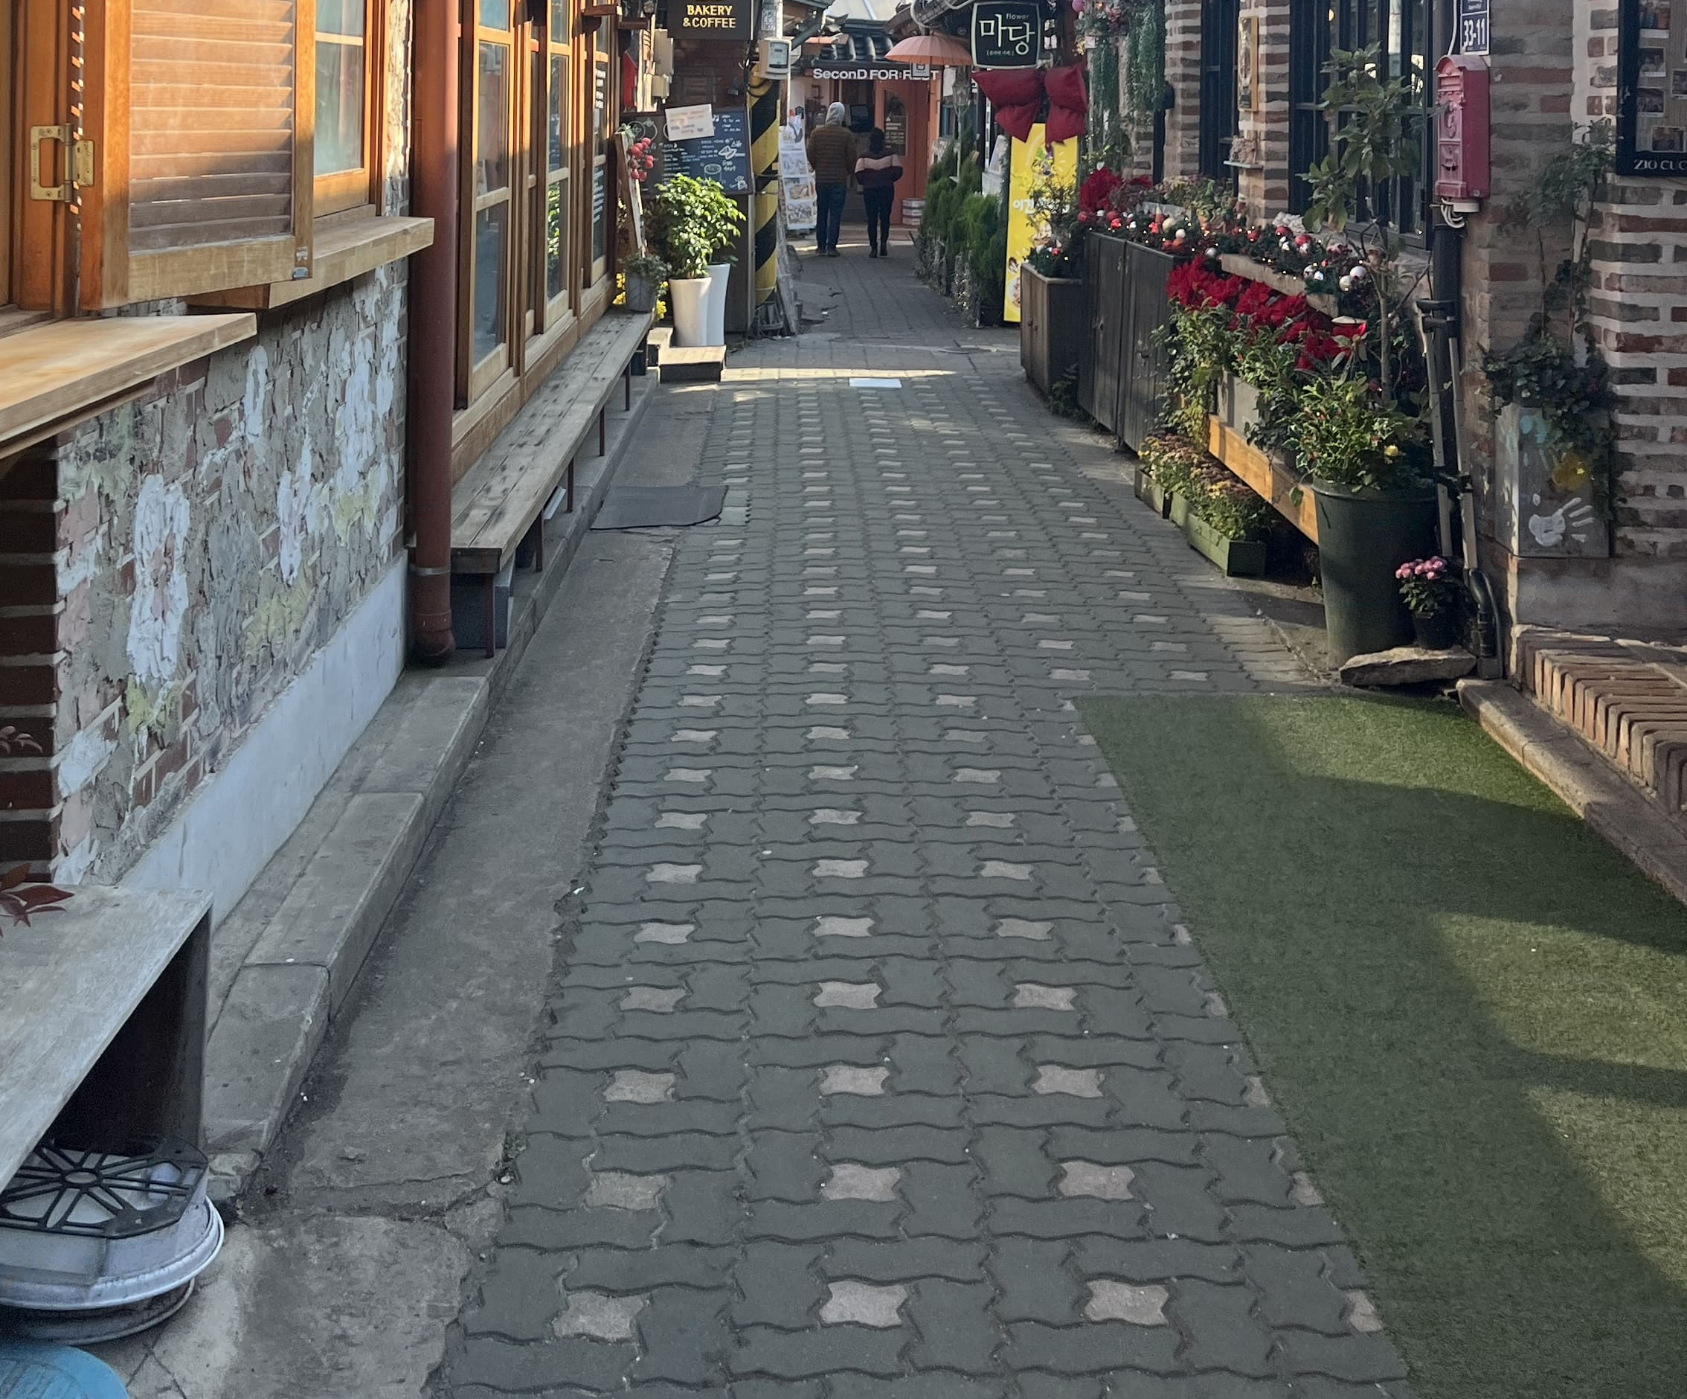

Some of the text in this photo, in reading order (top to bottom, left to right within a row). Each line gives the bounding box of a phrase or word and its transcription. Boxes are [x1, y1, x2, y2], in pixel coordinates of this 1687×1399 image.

[686, 4, 733, 16] BAKERY
[1005, 12, 1030, 20] flower
[979, 13, 1036, 56] 마당
[1463, 18, 1486, 46] 33-11
[812, 68, 868, 80] SeconD
[1633, 159, 1658, 170] ZIO
